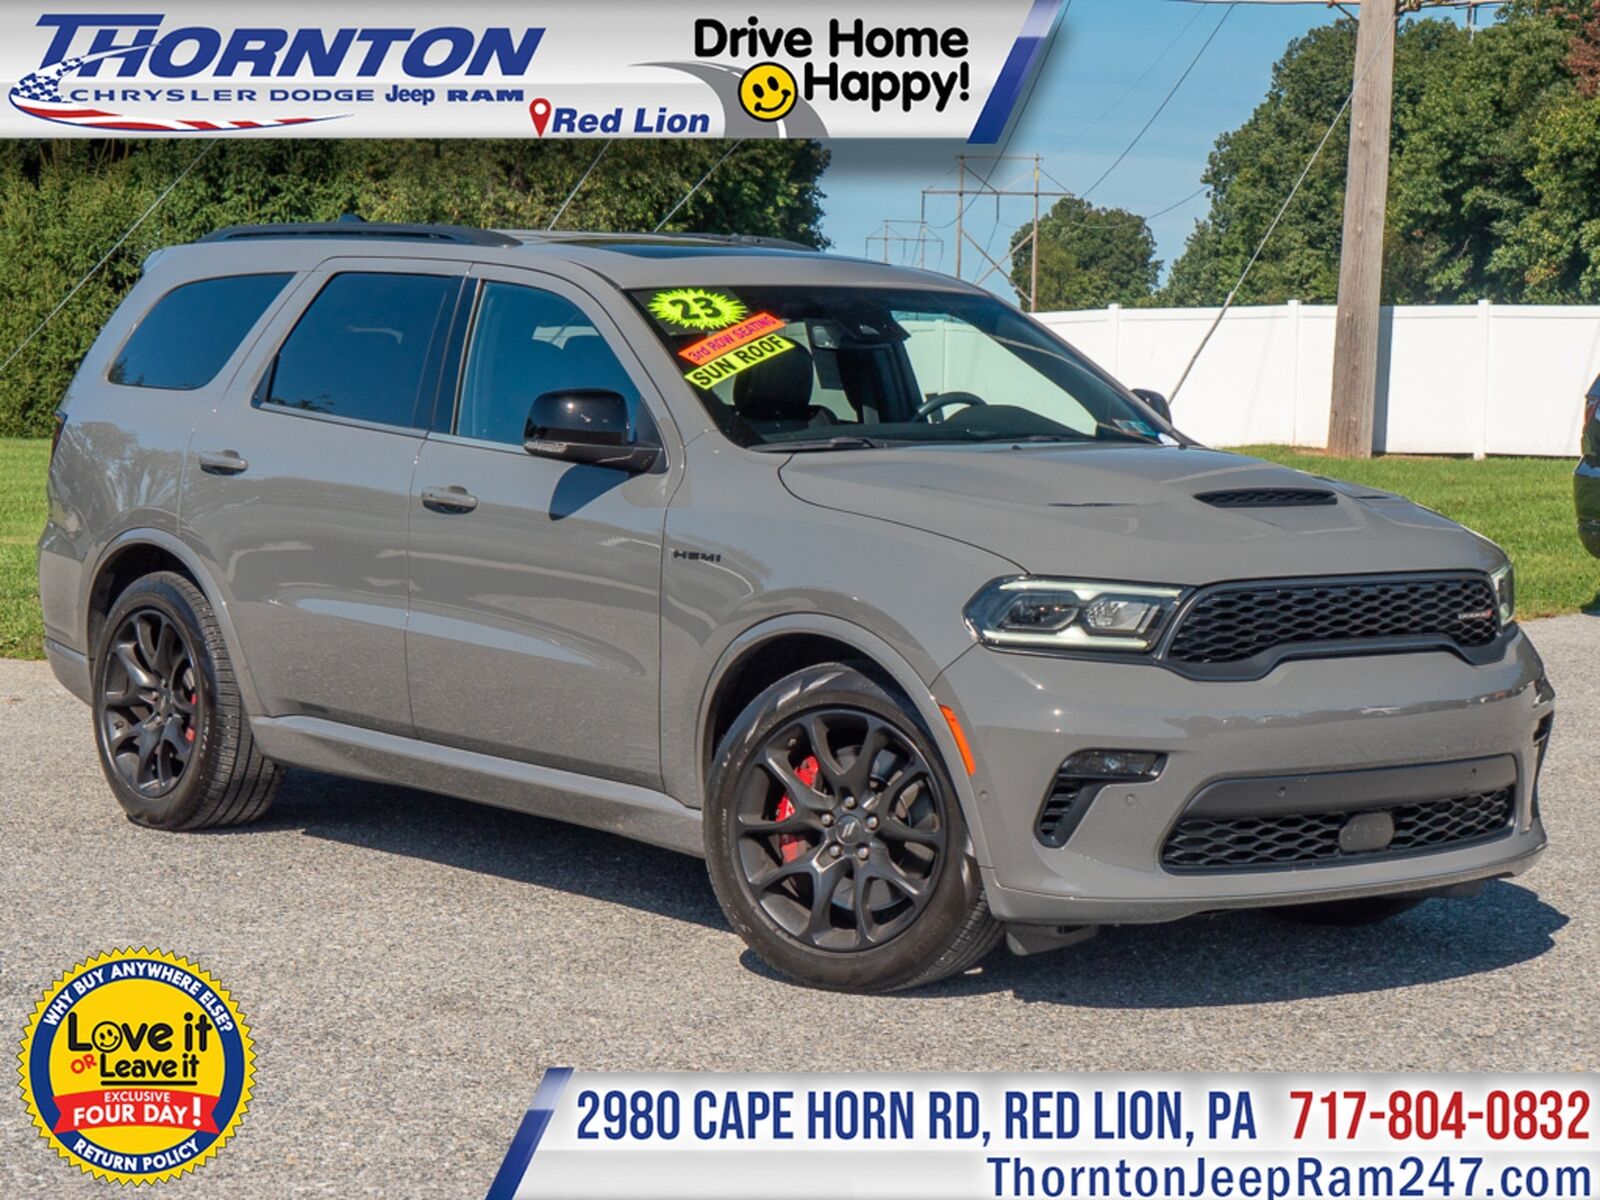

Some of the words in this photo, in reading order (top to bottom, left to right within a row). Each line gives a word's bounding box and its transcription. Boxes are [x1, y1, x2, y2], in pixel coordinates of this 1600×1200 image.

[669, 297, 723, 320] 23
[688, 346, 711, 362] 3rd
[708, 334, 734, 351] ROW
[732, 317, 777, 339] SEATING
[692, 357, 734, 386] SUN
[734, 335, 784, 364] ROOF
[673, 550, 721, 562] HEMI
